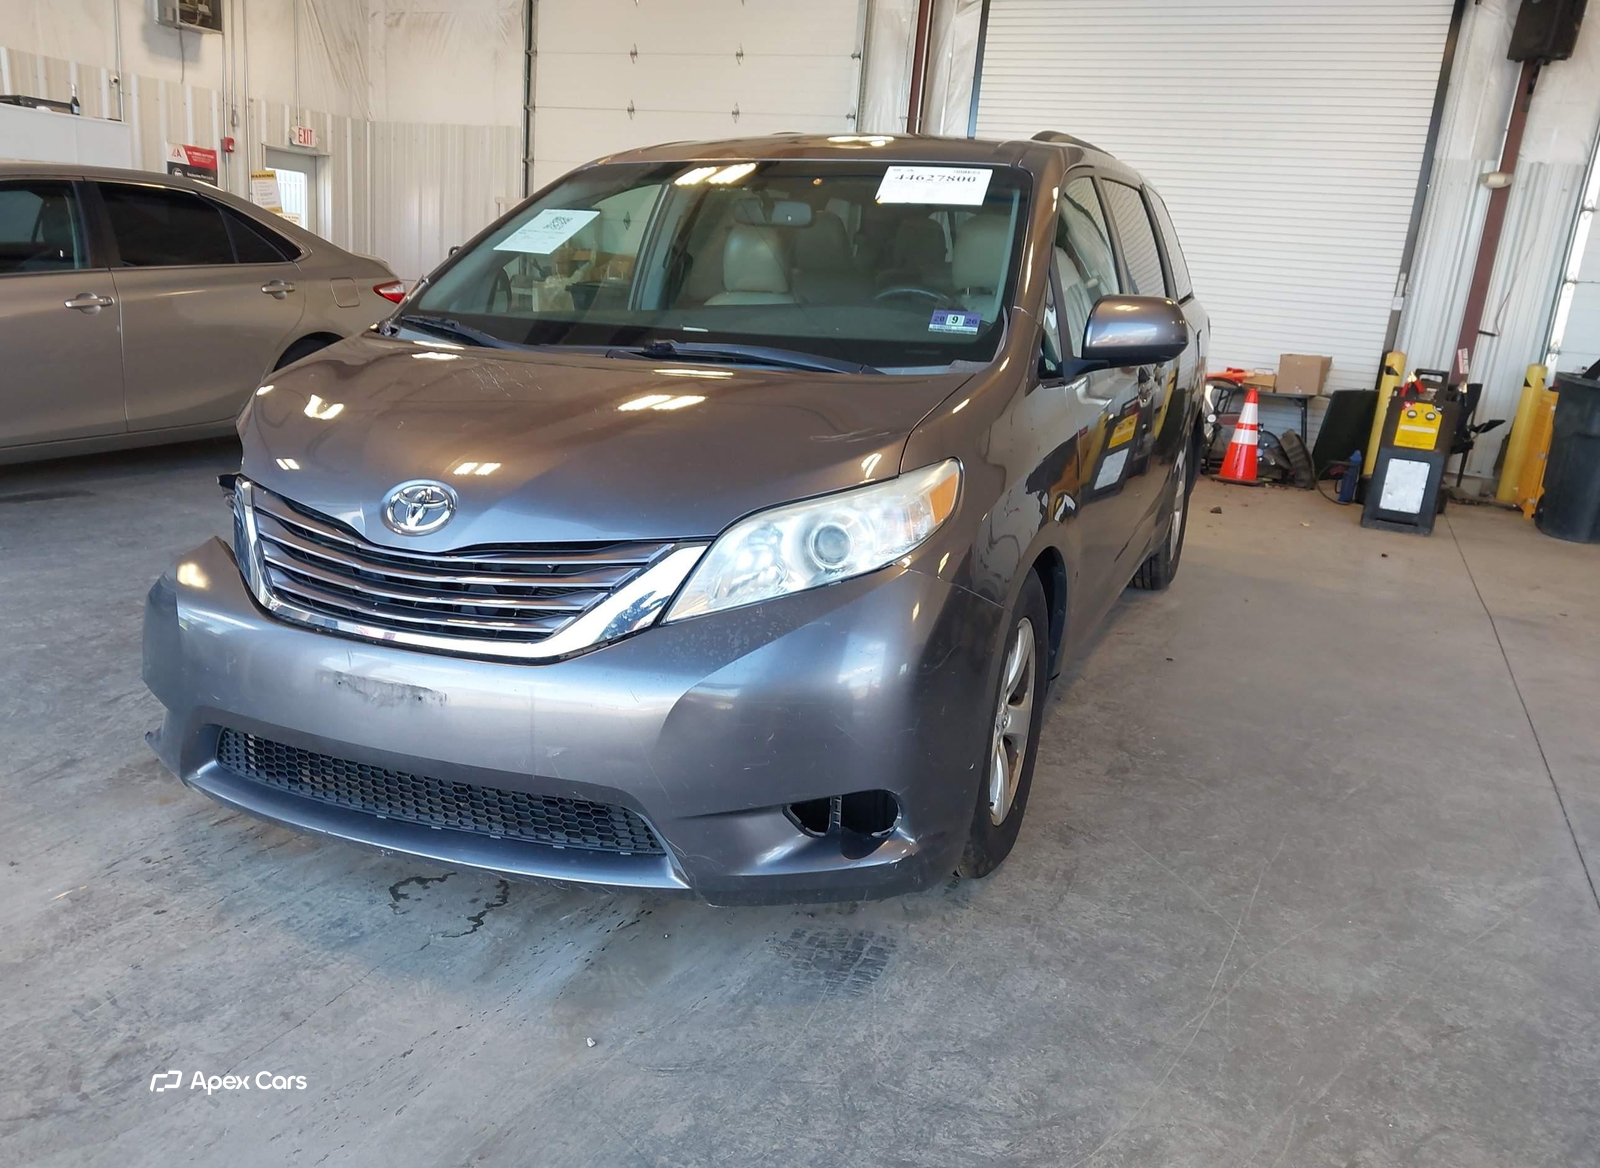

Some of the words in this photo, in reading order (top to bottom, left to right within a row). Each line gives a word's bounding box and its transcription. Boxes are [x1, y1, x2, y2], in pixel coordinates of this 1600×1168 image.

[298, 127, 313, 146] EXIT
[894, 173, 977, 183] 44627800
[951, 315, 959, 324] 9
